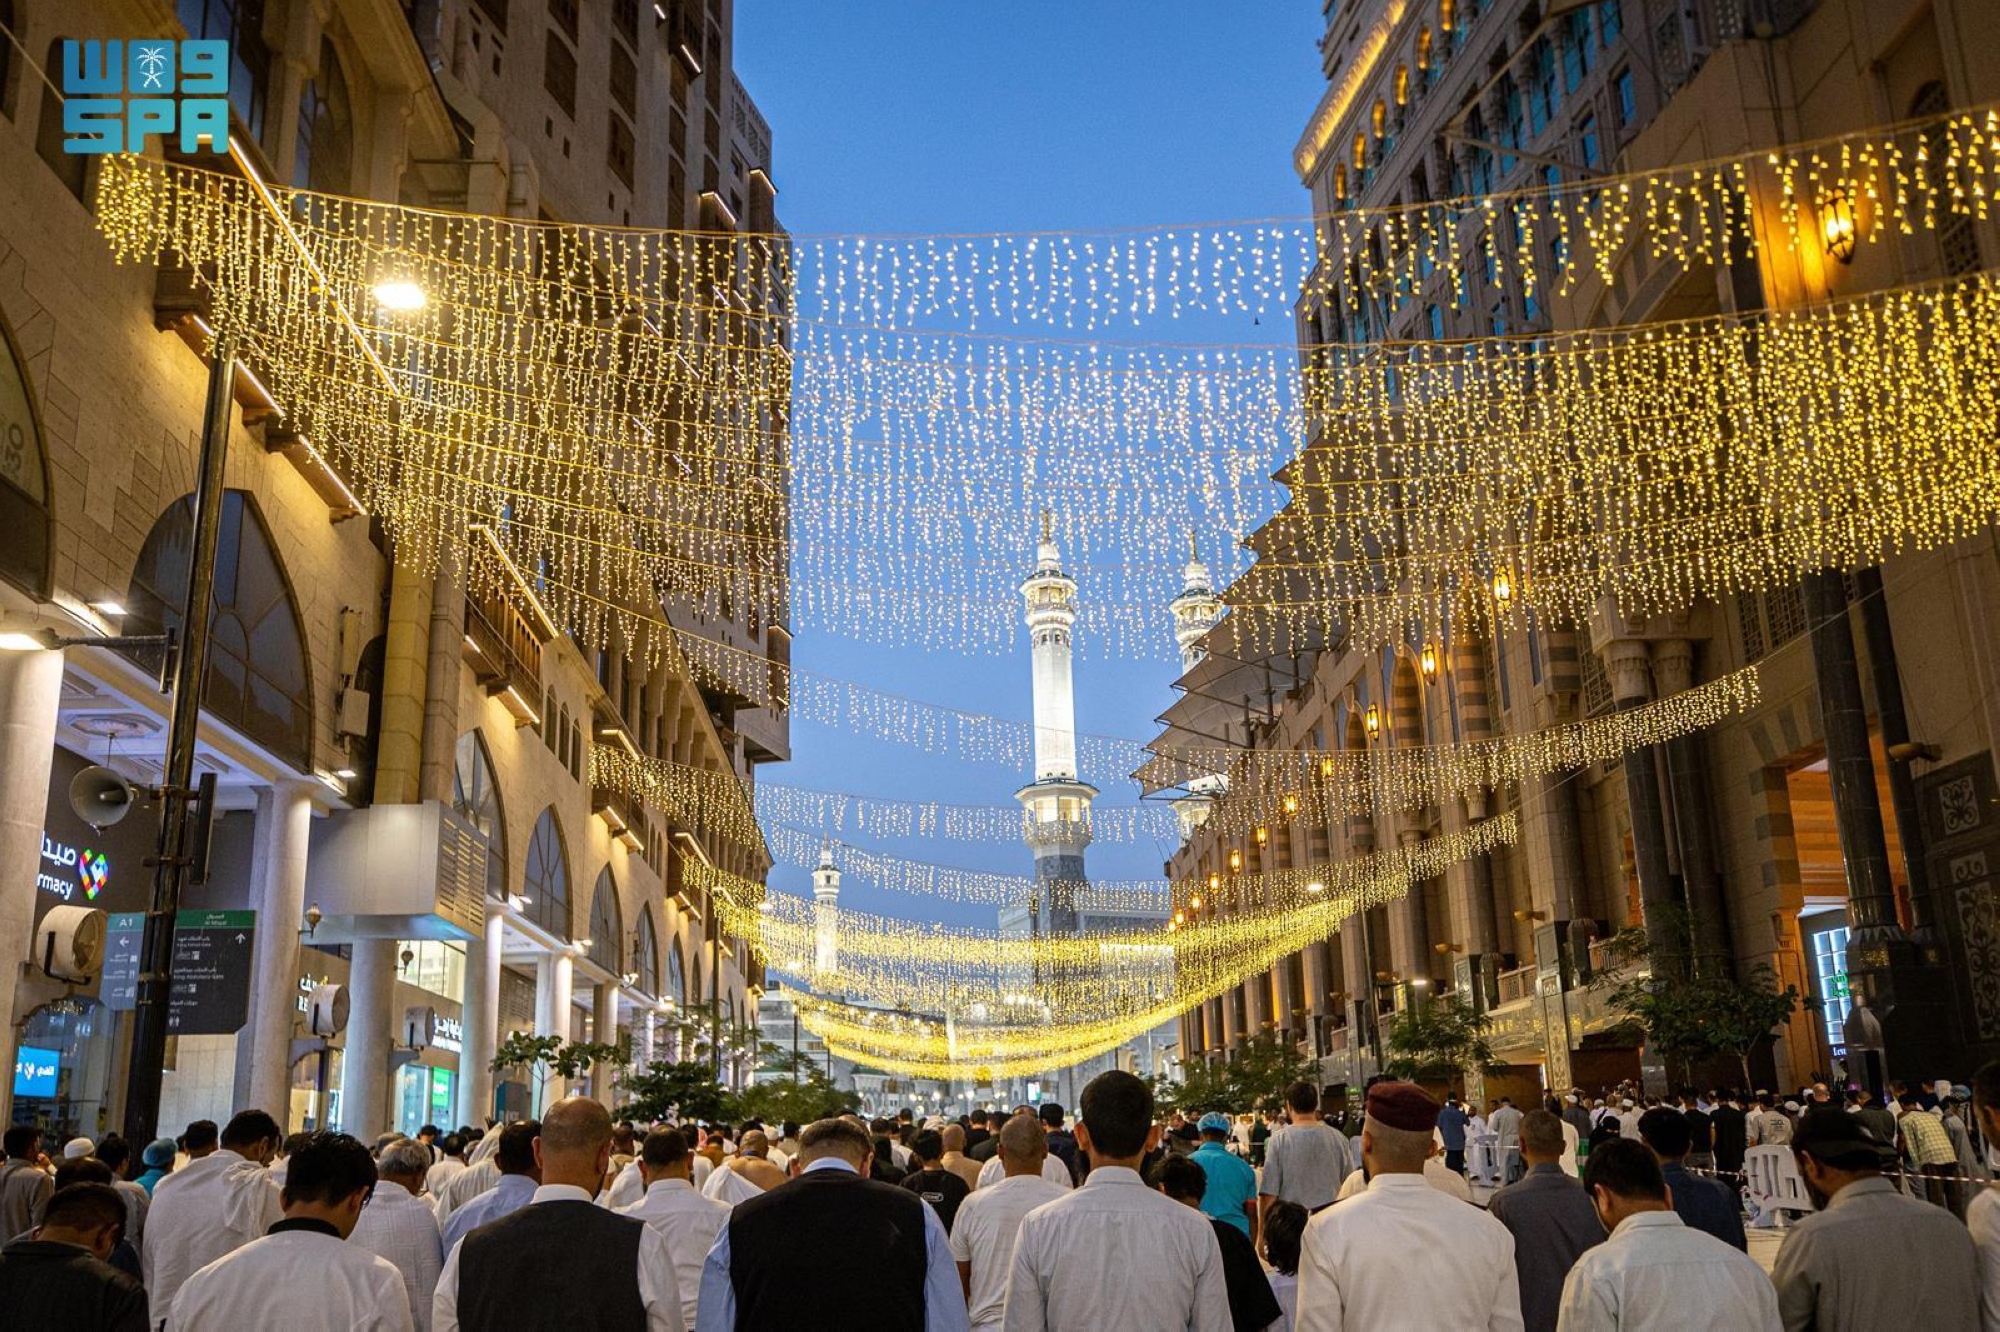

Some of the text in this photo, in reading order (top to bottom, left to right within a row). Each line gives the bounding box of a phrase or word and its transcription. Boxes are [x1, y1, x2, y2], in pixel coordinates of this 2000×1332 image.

[41, 831, 76, 867] صيدل
[37, 873, 73, 901] rmacy
[119, 918, 133, 927] A1
[298, 995, 309, 1012] RE
